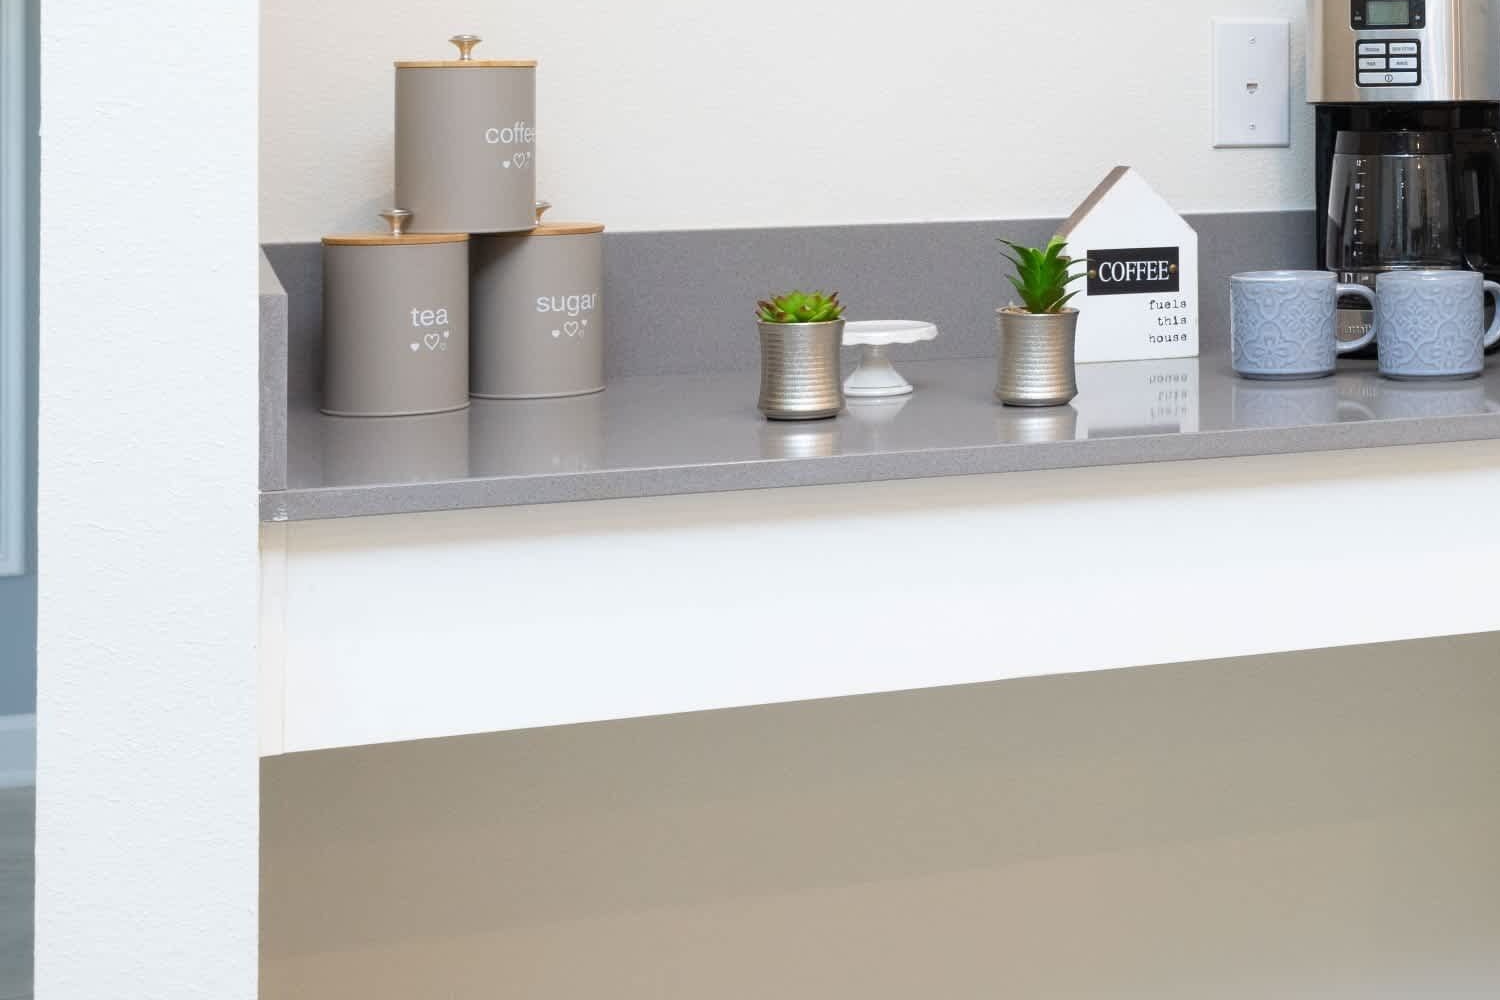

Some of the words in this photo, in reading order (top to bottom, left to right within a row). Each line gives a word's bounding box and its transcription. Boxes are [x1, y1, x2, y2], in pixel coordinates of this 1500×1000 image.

[1098, 260, 1170, 282] COFFEE
[536, 292, 597, 317] sugar
[1149, 299, 1187, 310] fuels
[410, 306, 449, 326] tea
[1157, 315, 1187, 326] this
[1149, 332, 1187, 344] house
